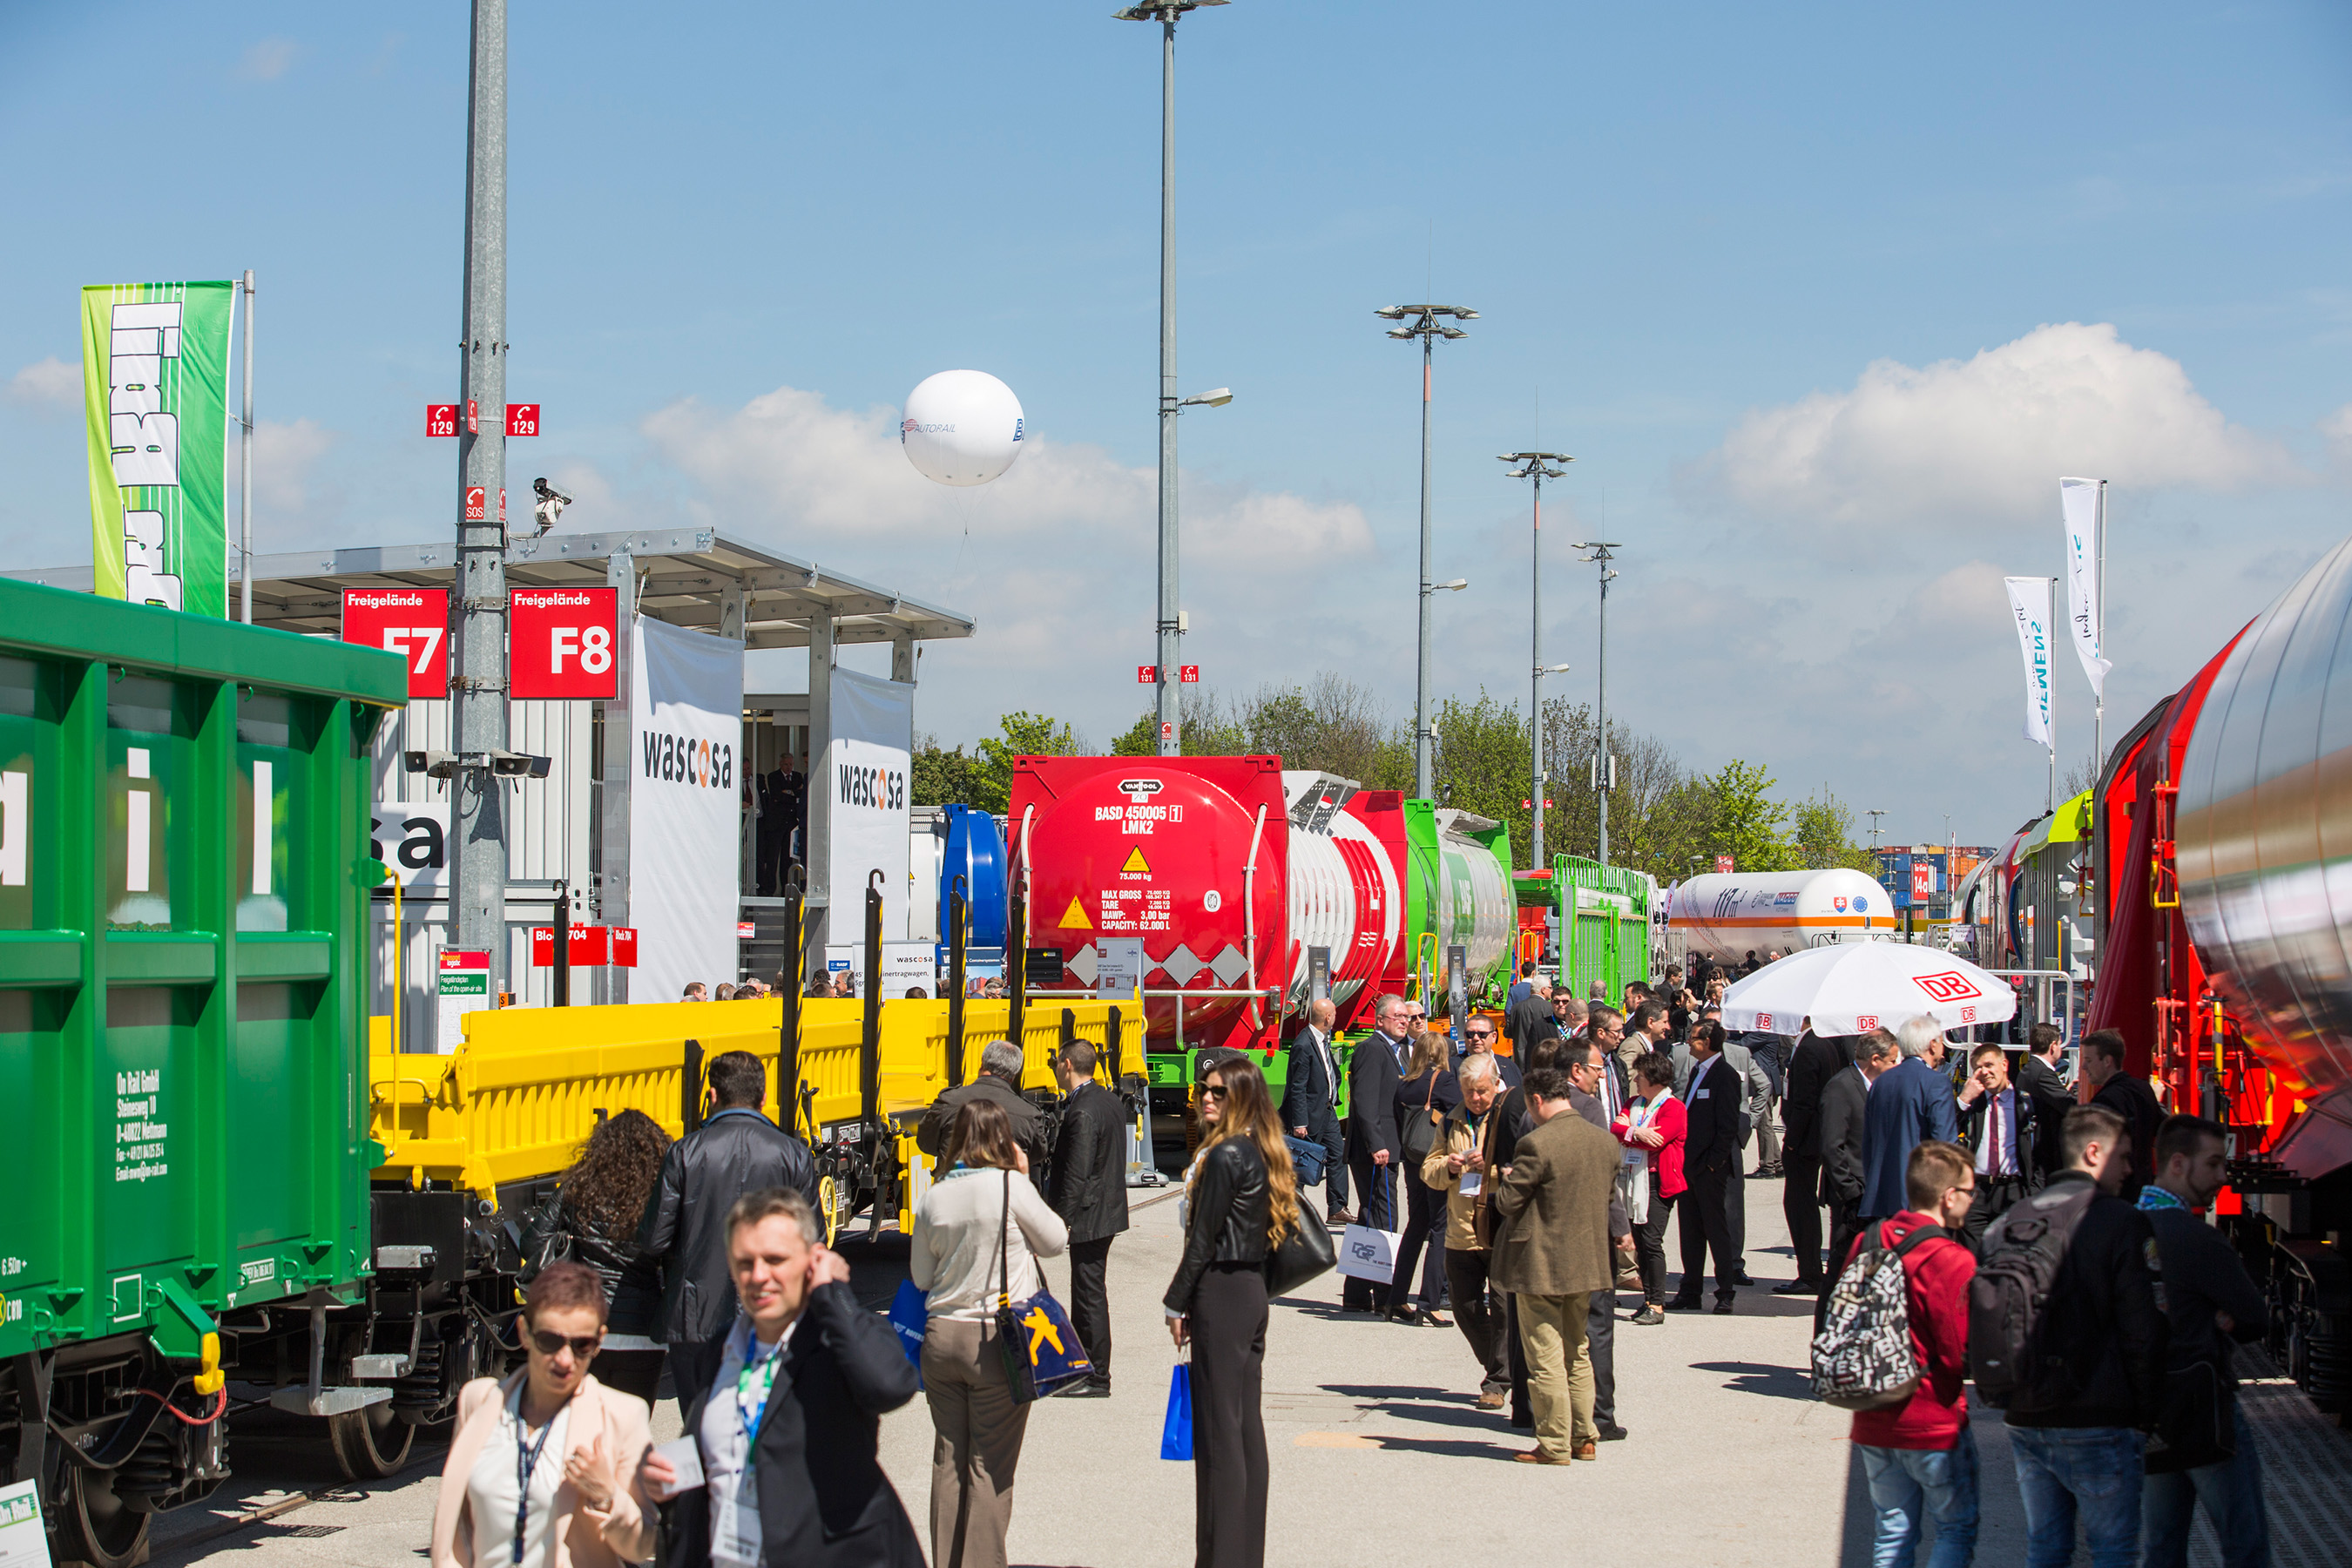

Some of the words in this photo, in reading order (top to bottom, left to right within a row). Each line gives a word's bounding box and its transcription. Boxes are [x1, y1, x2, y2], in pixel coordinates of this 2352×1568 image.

[109, 301, 181, 487] Rail
[430, 421, 454, 435] 129
[512, 420, 535, 434] 129
[914, 423, 956, 433] AUTORAIL
[466, 506, 483, 517] SOS
[348, 593, 423, 608] Freigelände
[514, 593, 591, 608] Freigelände
[383, 627, 443, 674] F7
[551, 625, 612, 674] F8
[643, 730, 732, 789] wascosa
[840, 763, 903, 810] wascosa
[1095, 807, 1124, 821] BASD
[1125, 806, 1166, 820] 450005
[1122, 821, 1153, 835] LMK2
[1143, 873, 1152, 882] kg
[1914, 875, 1928, 893] 14a
[1101, 890, 1119, 900] MAX
[1119, 890, 1142, 900] GROSS
[1776, 893, 1799, 903] NACCO
[1101, 901, 1119, 909] TARE
[1101, 911, 1125, 920] MAWP:
[1140, 910, 1158, 921] 3,00
[1159, 911, 1170, 920] bar
[1101, 921, 1138, 930] CAPACITY:
[1139, 921, 1165, 930] 62.000
[1166, 921, 1170, 930] L
[568, 930, 587, 940] 704
[1922, 977, 1971, 998] DB
[1757, 1015, 1770, 1028] DB
[1963, 1008, 1975, 1021] DB
[1860, 1017, 1876, 1030] DB
[117, 1071, 126, 1095] On
[127, 1070, 140, 1094] Rail
[141, 1069, 159, 1093] GmbH
